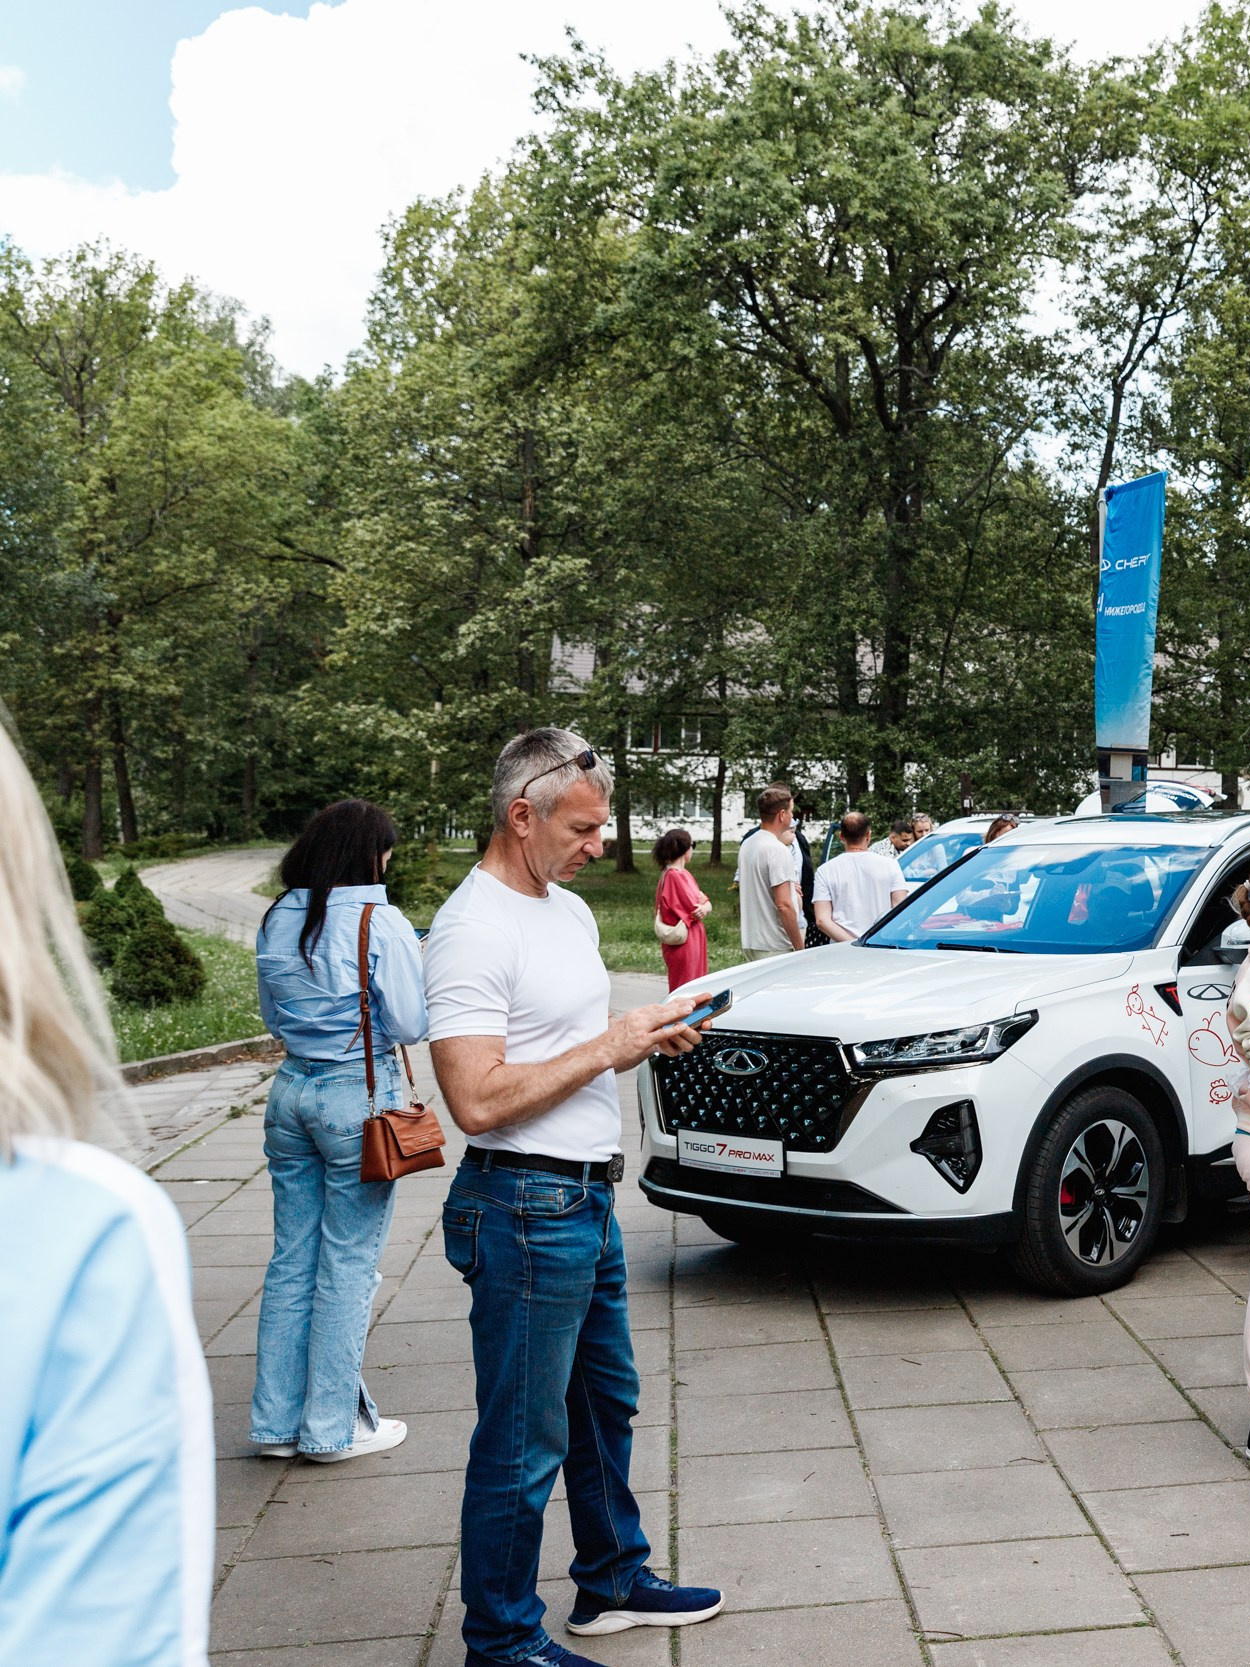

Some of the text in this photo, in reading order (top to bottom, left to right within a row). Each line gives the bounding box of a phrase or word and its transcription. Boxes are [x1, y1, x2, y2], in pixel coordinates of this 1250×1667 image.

[684, 1141, 775, 1162] TIGGO 7 PRO MAX
